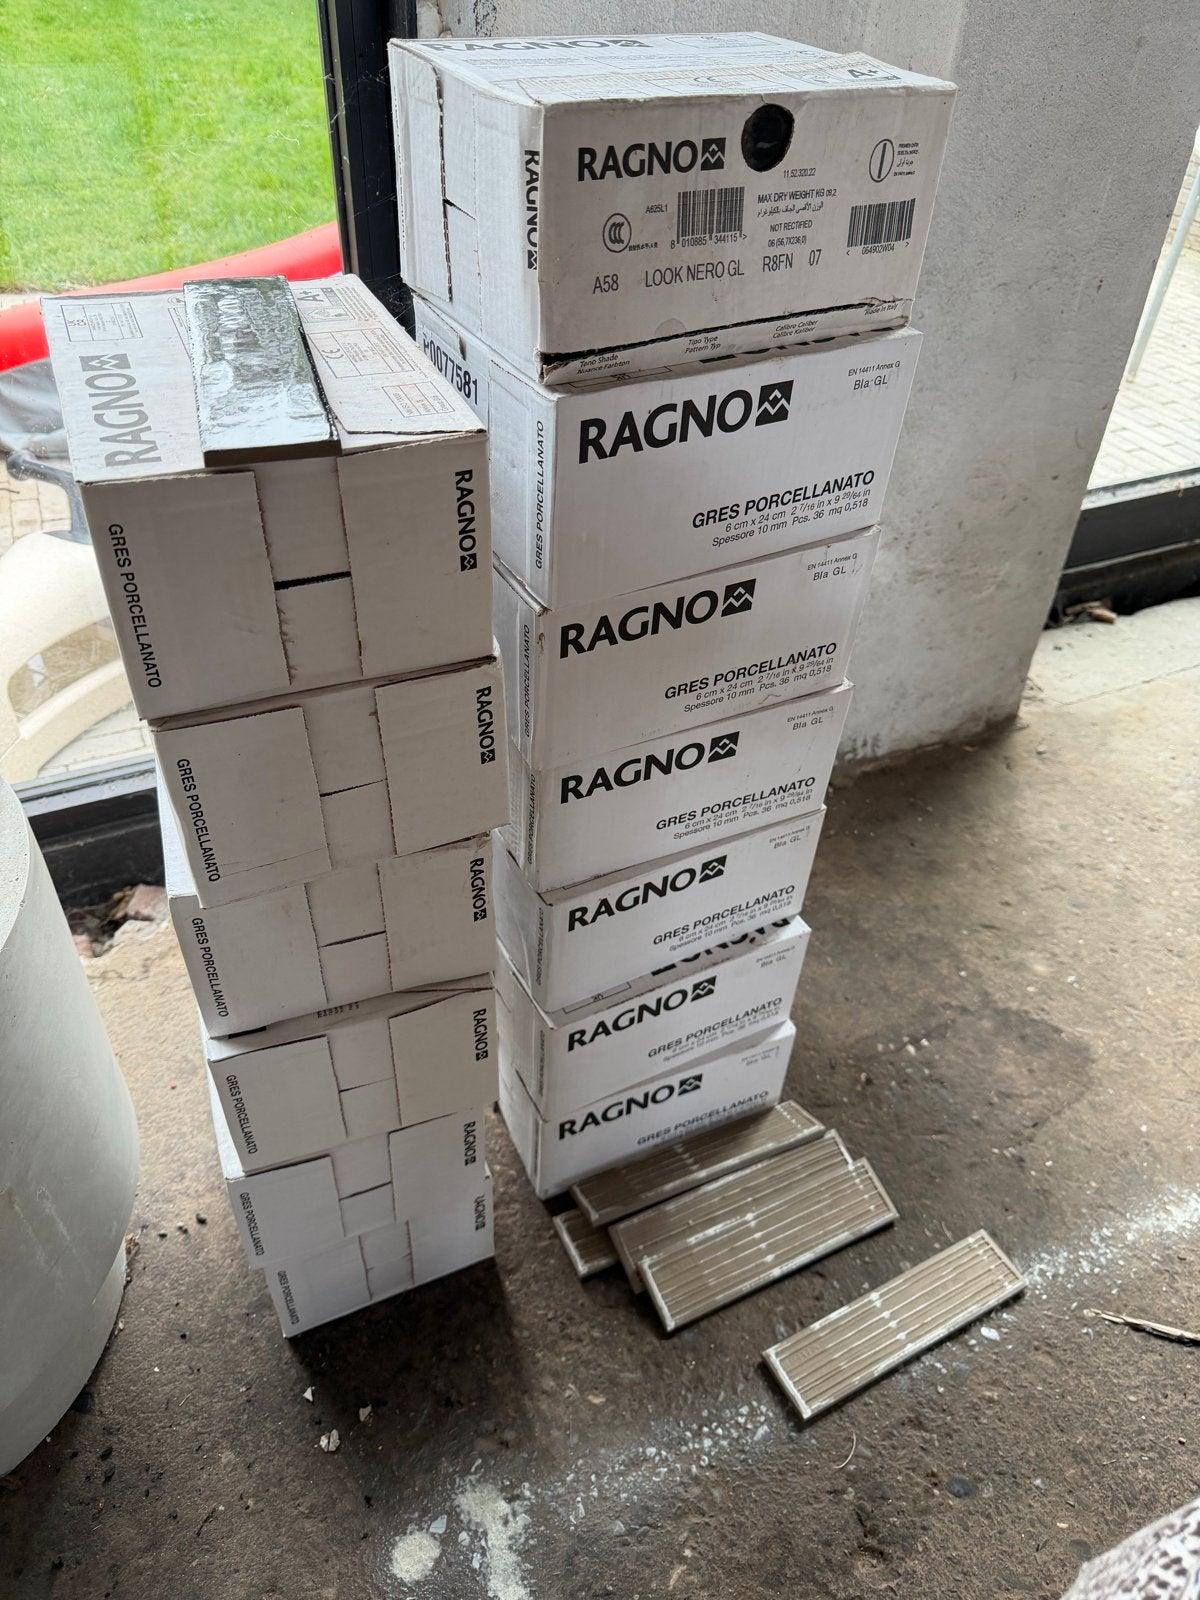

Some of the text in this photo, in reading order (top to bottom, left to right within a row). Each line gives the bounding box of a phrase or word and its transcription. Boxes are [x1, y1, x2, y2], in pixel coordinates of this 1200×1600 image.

[420, 40, 609, 52] RAGNO
[846, 67, 879, 79] A+
[577, 139, 698, 182] RAGNO
[524, 149, 540, 248] RAGNO
[757, 193, 772, 204] MAX
[774, 191, 788, 202] DRY
[789, 189, 815, 200] WEIGHT
[816, 188, 825, 198] KG
[670, 239, 676, 249] 8
[681, 236, 707, 248] 010885
[714, 233, 738, 244] 344115
[770, 220, 812, 232] NOT RECTIFIED
[593, 248, 822, 294] A58 LOOK NERO GL R8FN 07
[598, 353, 619, 364] Shade
[688, 336, 718, 346] Tipo Type
[710, 342, 721, 351] Typ
[848, 368, 857, 377] EN
[859, 365, 875, 374] 14411
[873, 375, 888, 386] GL
[85, 373, 162, 467] RAGNO
[578, 390, 753, 464] RAGNO
[455, 468, 476, 552] RAGNO
[535, 420, 545, 570] GRES PORCELLANATO
[692, 470, 875, 529] GRES PORCELLANATO
[725, 523, 732, 533] 6
[733, 520, 748, 531] cm
[758, 513, 770, 524] 24
[771, 511, 786, 520] cm
[790, 506, 797, 516] 2
[816, 499, 825, 508] in
[834, 495, 840, 504] 9
[862, 488, 871, 497] in
[712, 498, 868, 547] Spessore 10 mm Pcs. 36 mq 0,518
[832, 565, 846, 576] GL
[108, 523, 162, 688] GRES PORCELLANATO
[559, 589, 719, 659] RAGNO
[664, 642, 837, 700] GRES PORCELLANATO
[684, 665, 832, 712] Spessore 10 mm Pcs. 36 mq 0,518
[696, 692, 702, 701] 6
[703, 689, 718, 699] cm
[726, 683, 738, 692] 24
[739, 680, 753, 689] cm
[757, 676, 764, 684] 2
[782, 669, 790, 677] in
[798, 664, 805, 672] 9
[825, 656, 834, 664] in
[476, 685, 495, 749] RAGNO
[811, 717, 823, 725] GL
[560, 742, 705, 805] RAGNO
[176, 758, 221, 882] GRES PORCELLANATO
[656, 810, 697, 830] GRES
[700, 776, 816, 817] PORCELLANATO
[692, 819, 705, 828] cm
[712, 813, 724, 821] 24
[725, 810, 738, 818] cm
[673, 824, 711, 840] Spessore
[724, 816, 739, 825] mm
[470, 857, 486, 908] RAGNO
[567, 867, 697, 932] RAGNO
[653, 925, 690, 945] GRES
[693, 885, 795, 930] PORCELLANATO
[191, 917, 229, 1017] GRES PORCELLANATO
[472, 1008, 487, 1050] RAGNO
[567, 989, 688, 1052] RAGNO
[647, 1037, 682, 1058] GRES
[685, 997, 782, 1042] PORCELLANATO
[226, 1074, 257, 1155] GRES PORCELLANATO
[558, 1083, 676, 1140] RAGNO
[464, 1121, 477, 1157] RAGNO
